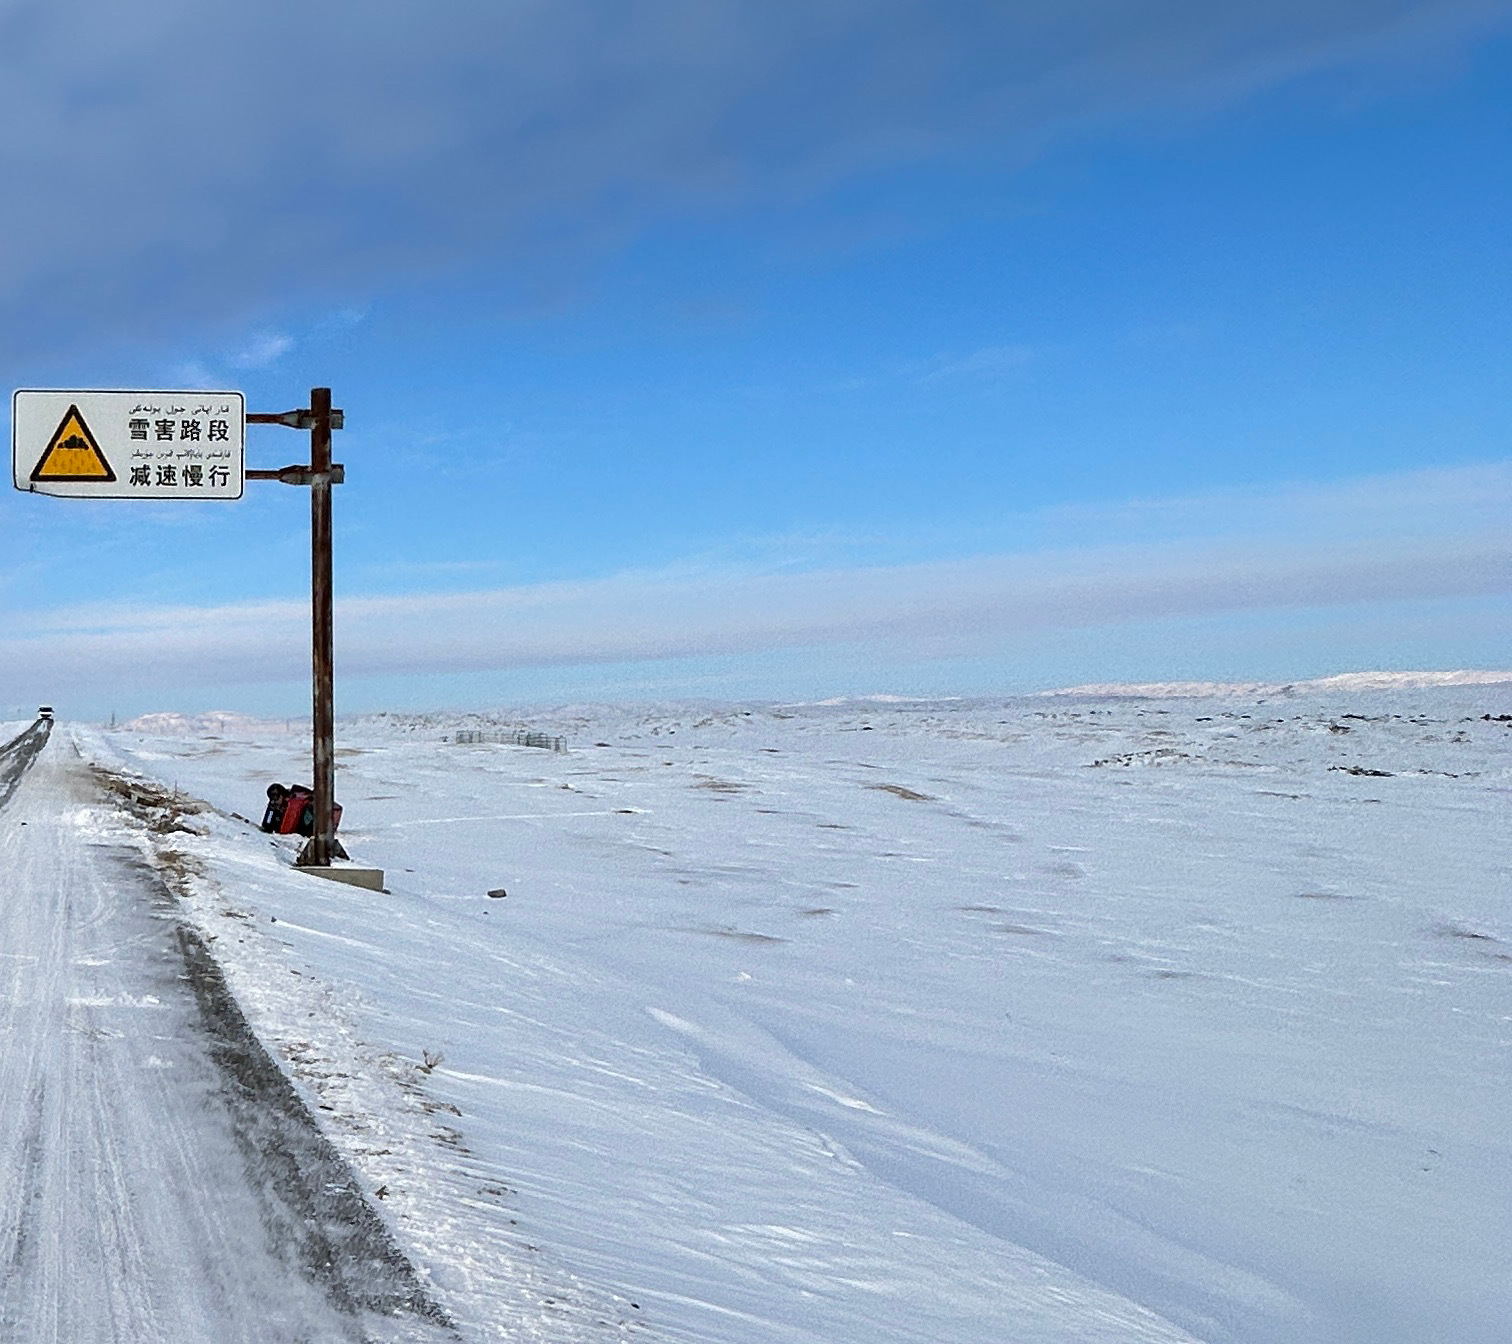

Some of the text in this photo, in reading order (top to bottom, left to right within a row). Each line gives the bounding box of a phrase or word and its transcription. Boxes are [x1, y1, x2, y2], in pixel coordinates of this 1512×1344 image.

[128, 418, 230, 442] 雪害路段
[129, 464, 231, 487] 减速慢行
